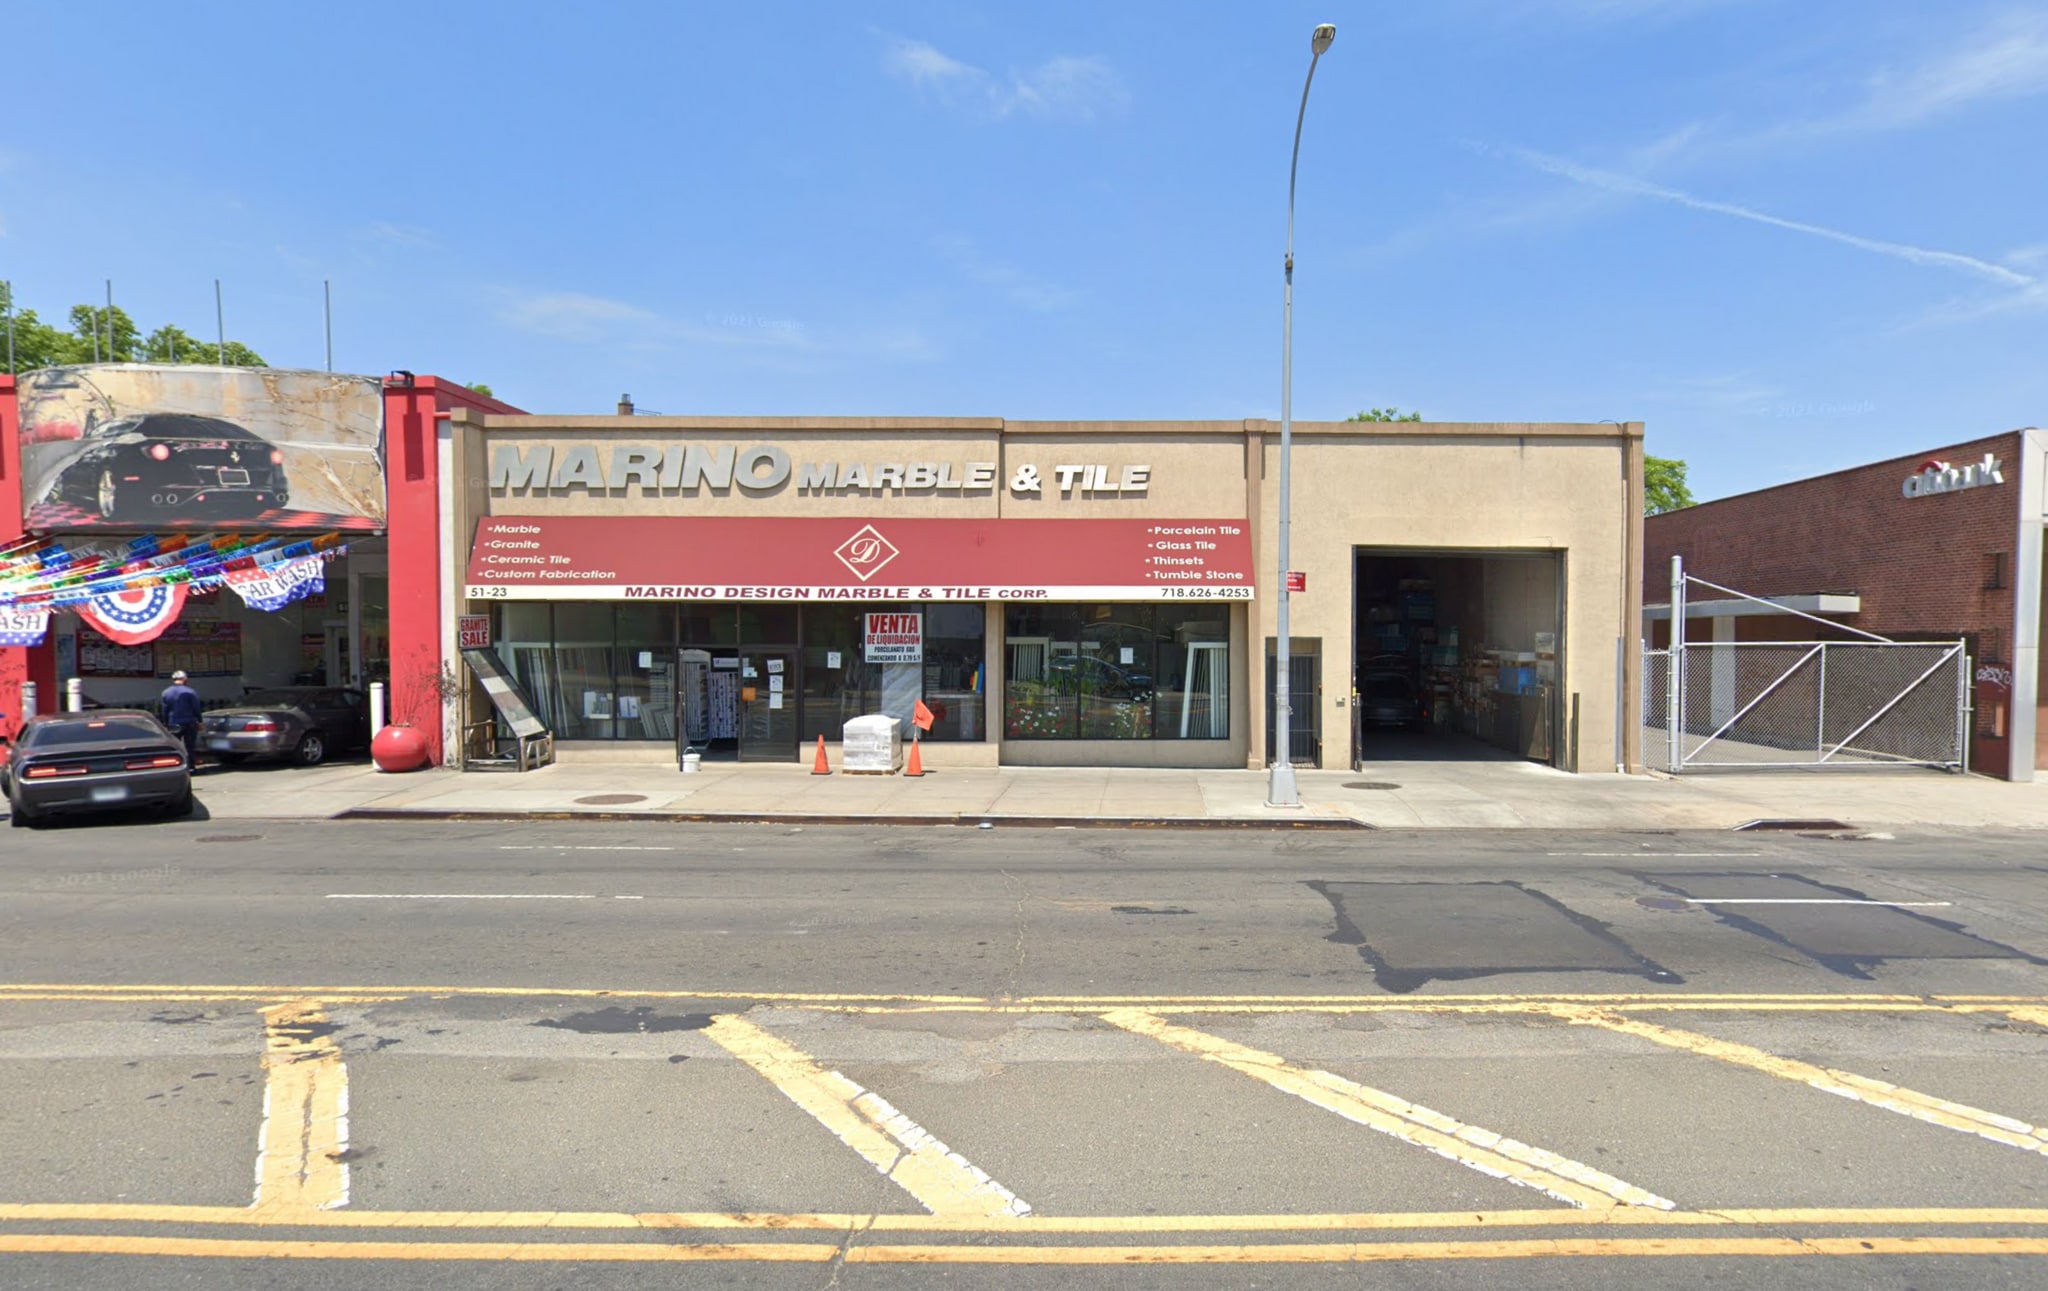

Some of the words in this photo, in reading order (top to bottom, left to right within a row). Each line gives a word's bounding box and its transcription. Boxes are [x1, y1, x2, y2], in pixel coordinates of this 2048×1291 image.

[490, 445, 791, 490] MARINO
[797, 462, 996, 489] MARBLE
[1010, 464, 1041, 491] &
[1055, 465, 1151, 491] TILE
[493, 525, 541, 534] Marble
[1154, 526, 1216, 535] Porcelain
[1219, 526, 1241, 535] Tile
[490, 540, 540, 549] Granite
[1156, 541, 1192, 550] Glass
[1194, 541, 1217, 550] Tile
[487, 555, 545, 564] Ceramic
[550, 555, 571, 564] Tile
[1153, 556, 1204, 565] Thinsets
[484, 570, 536, 579] Custom
[539, 570, 616, 579] Fabrication
[1153, 571, 1202, 580] Tumble
[1206, 571, 1244, 580] Stone
[470, 587, 507, 597] 51-23
[625, 587, 716, 598] MARINO
[724, 587, 810, 598] DESIGN
[817, 588, 910, 599] MARBLE
[918, 588, 933, 599] &
[942, 588, 991, 599] TILE
[998, 589, 1048, 599] CORP.
[1161, 588, 1249, 598] 718.626-4253
[461, 619, 488, 631] GRANITE
[868, 614, 919, 634] VENTA
[461, 631, 487, 647] SALE
[867, 634, 876, 645] DE
[877, 634, 920, 646] LIQUIDACION
